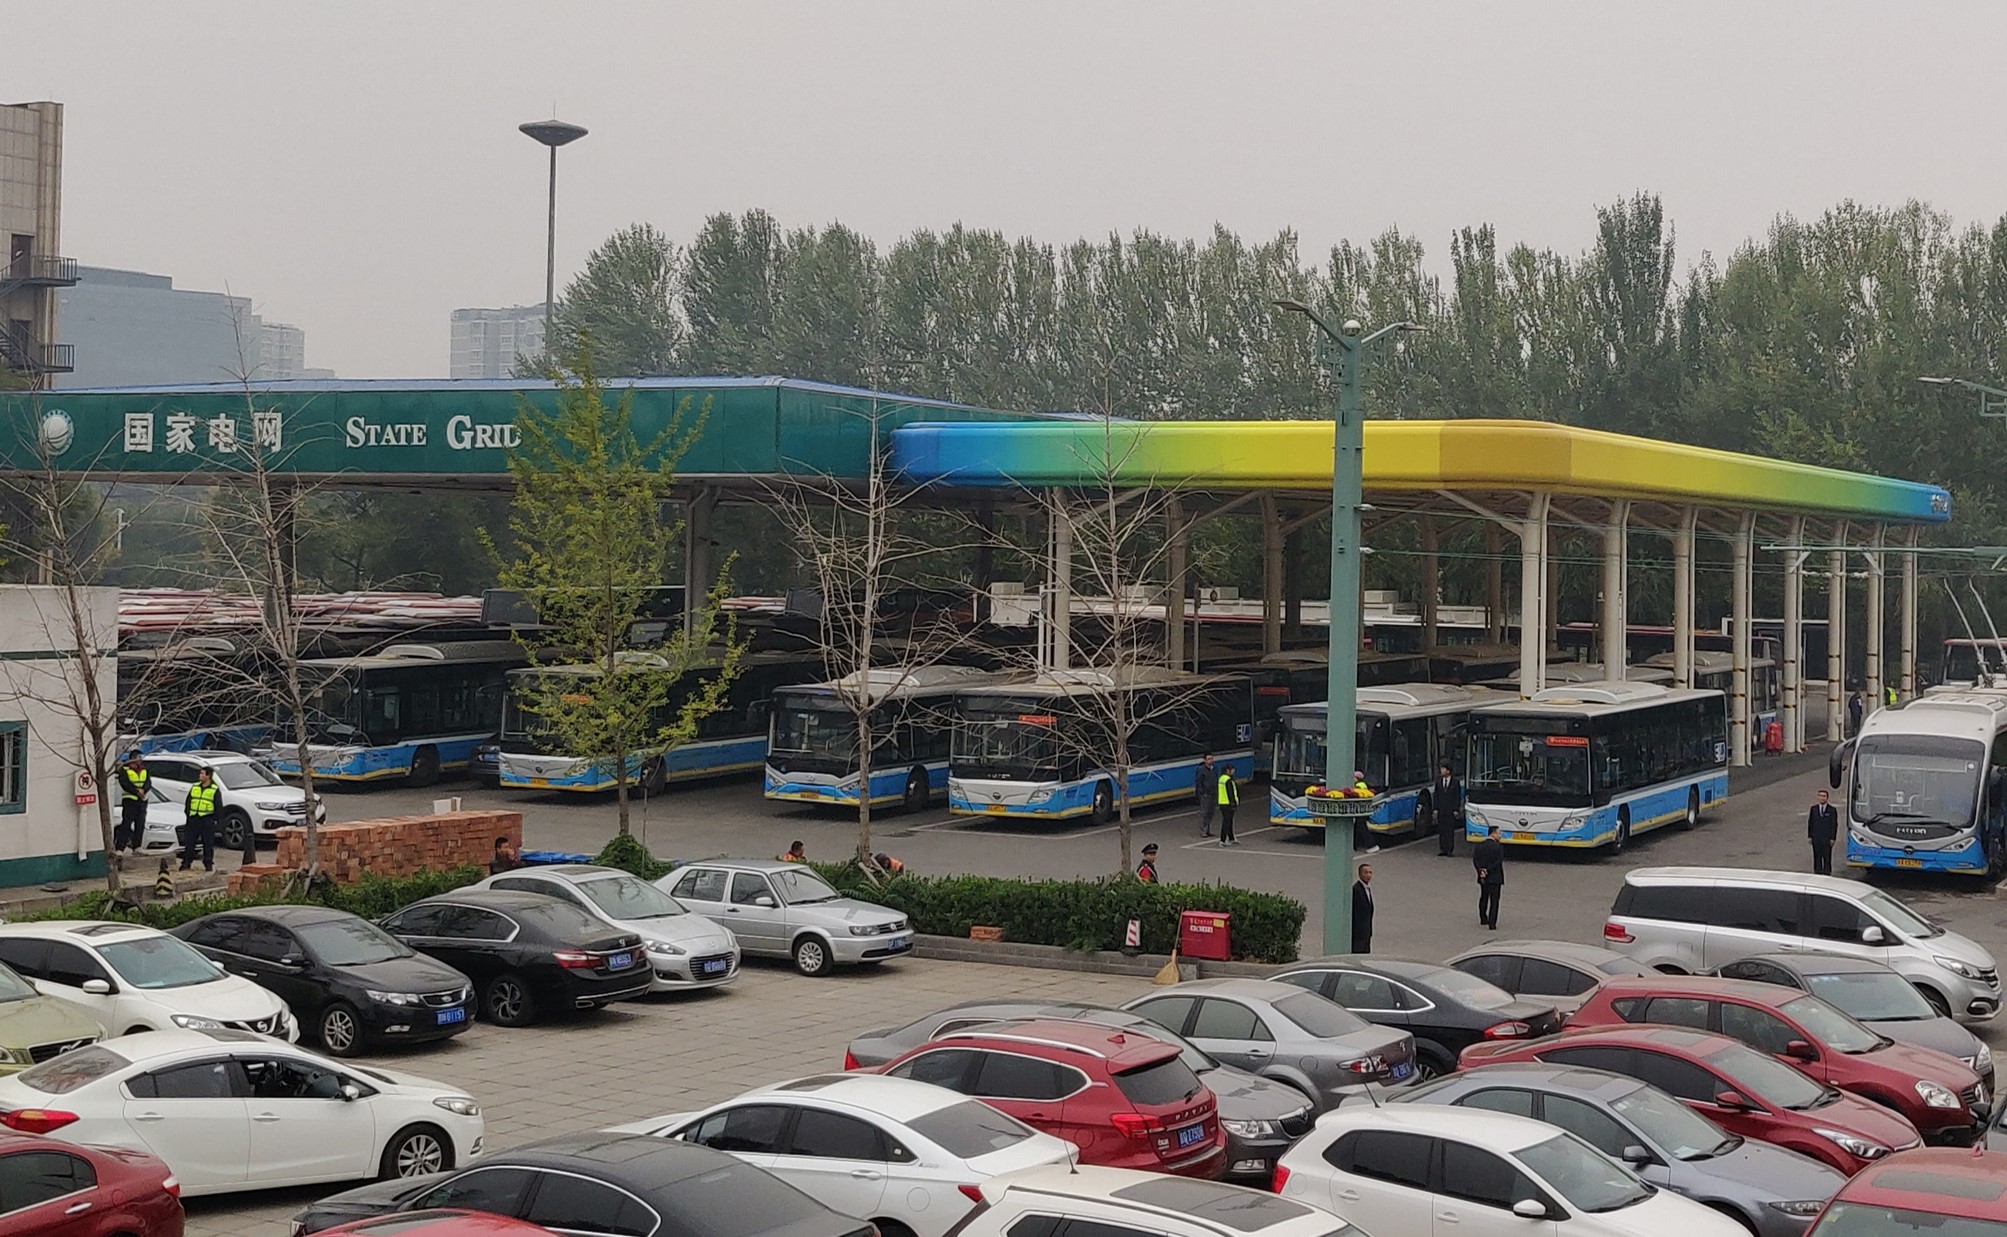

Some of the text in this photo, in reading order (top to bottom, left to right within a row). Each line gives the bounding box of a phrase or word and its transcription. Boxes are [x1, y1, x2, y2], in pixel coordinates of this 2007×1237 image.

[124, 412, 282, 453] 国家电网
[346, 415, 522, 450] STATE GRID
